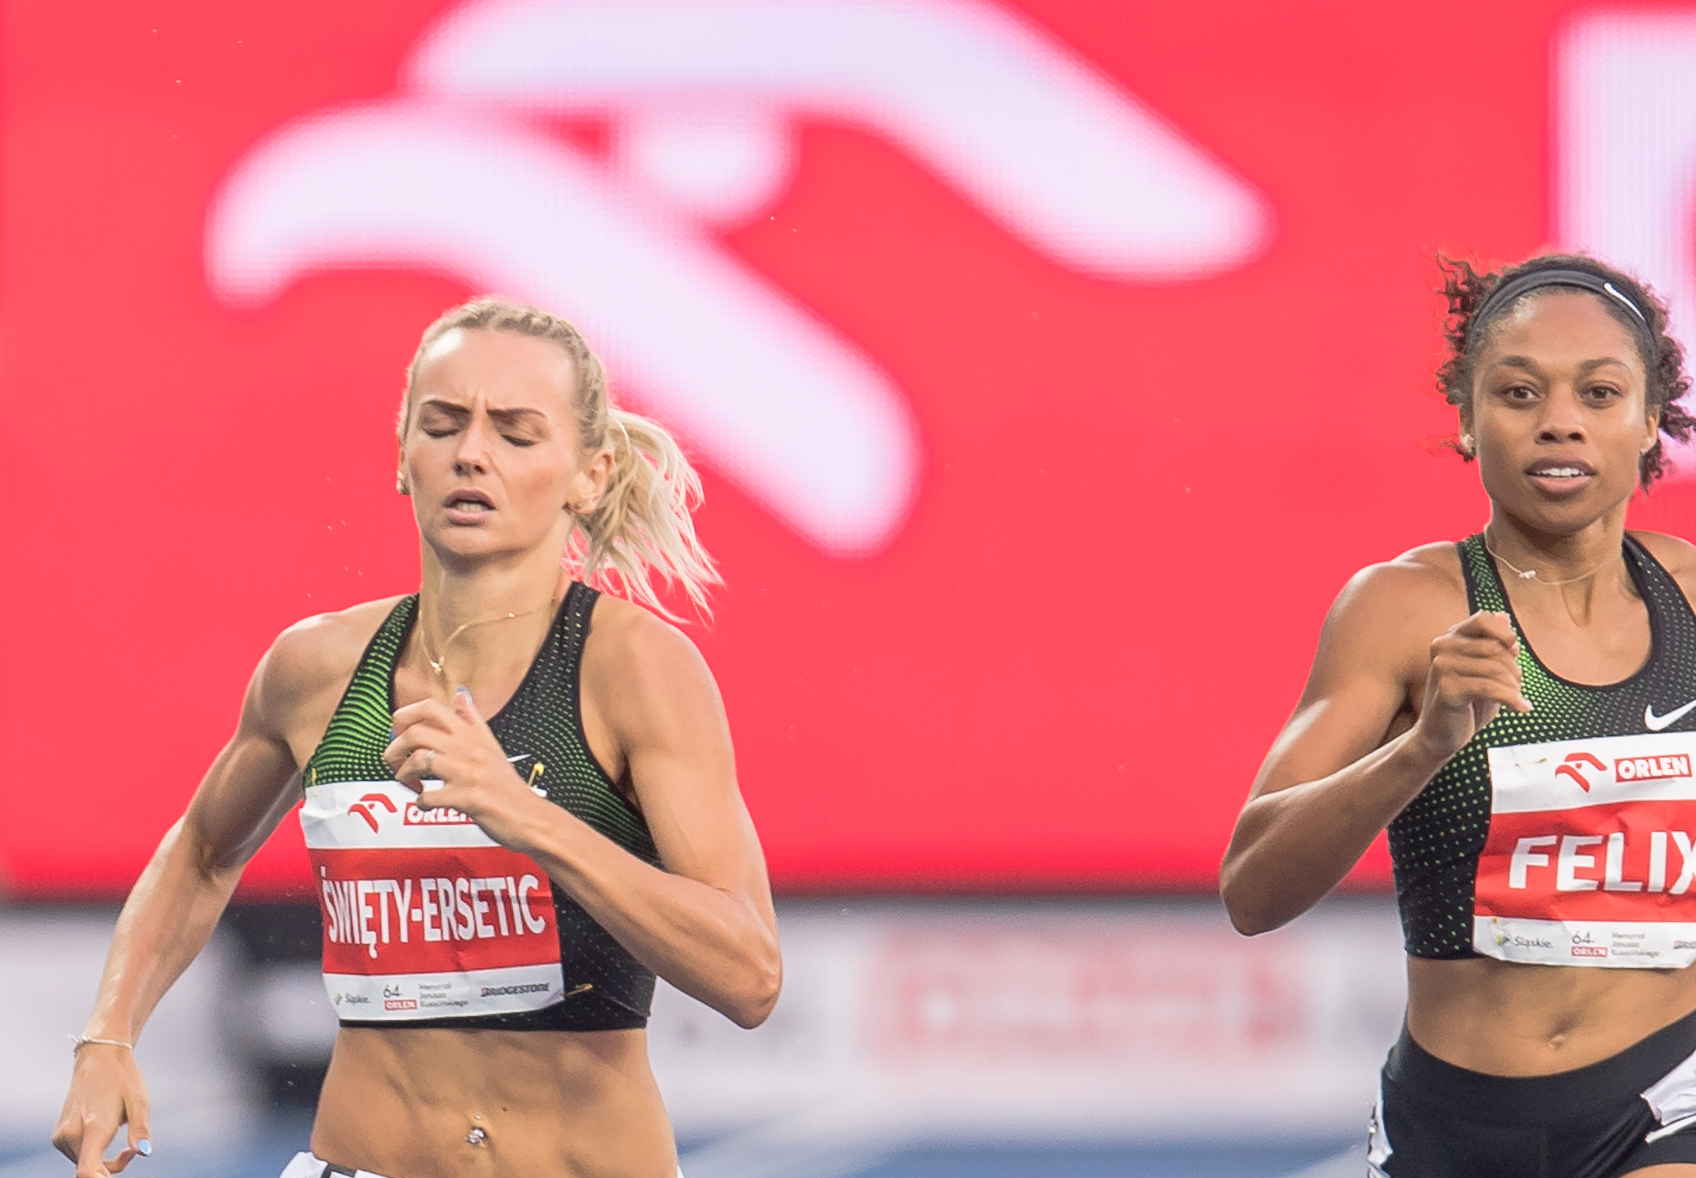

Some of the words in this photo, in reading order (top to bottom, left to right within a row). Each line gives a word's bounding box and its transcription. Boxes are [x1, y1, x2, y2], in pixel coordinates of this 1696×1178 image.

[1618, 757, 1690, 779] ORLEN
[320, 865, 546, 959] ŚWIĘTY-ERSETIC
[386, 1001, 416, 1009] ORLEN
